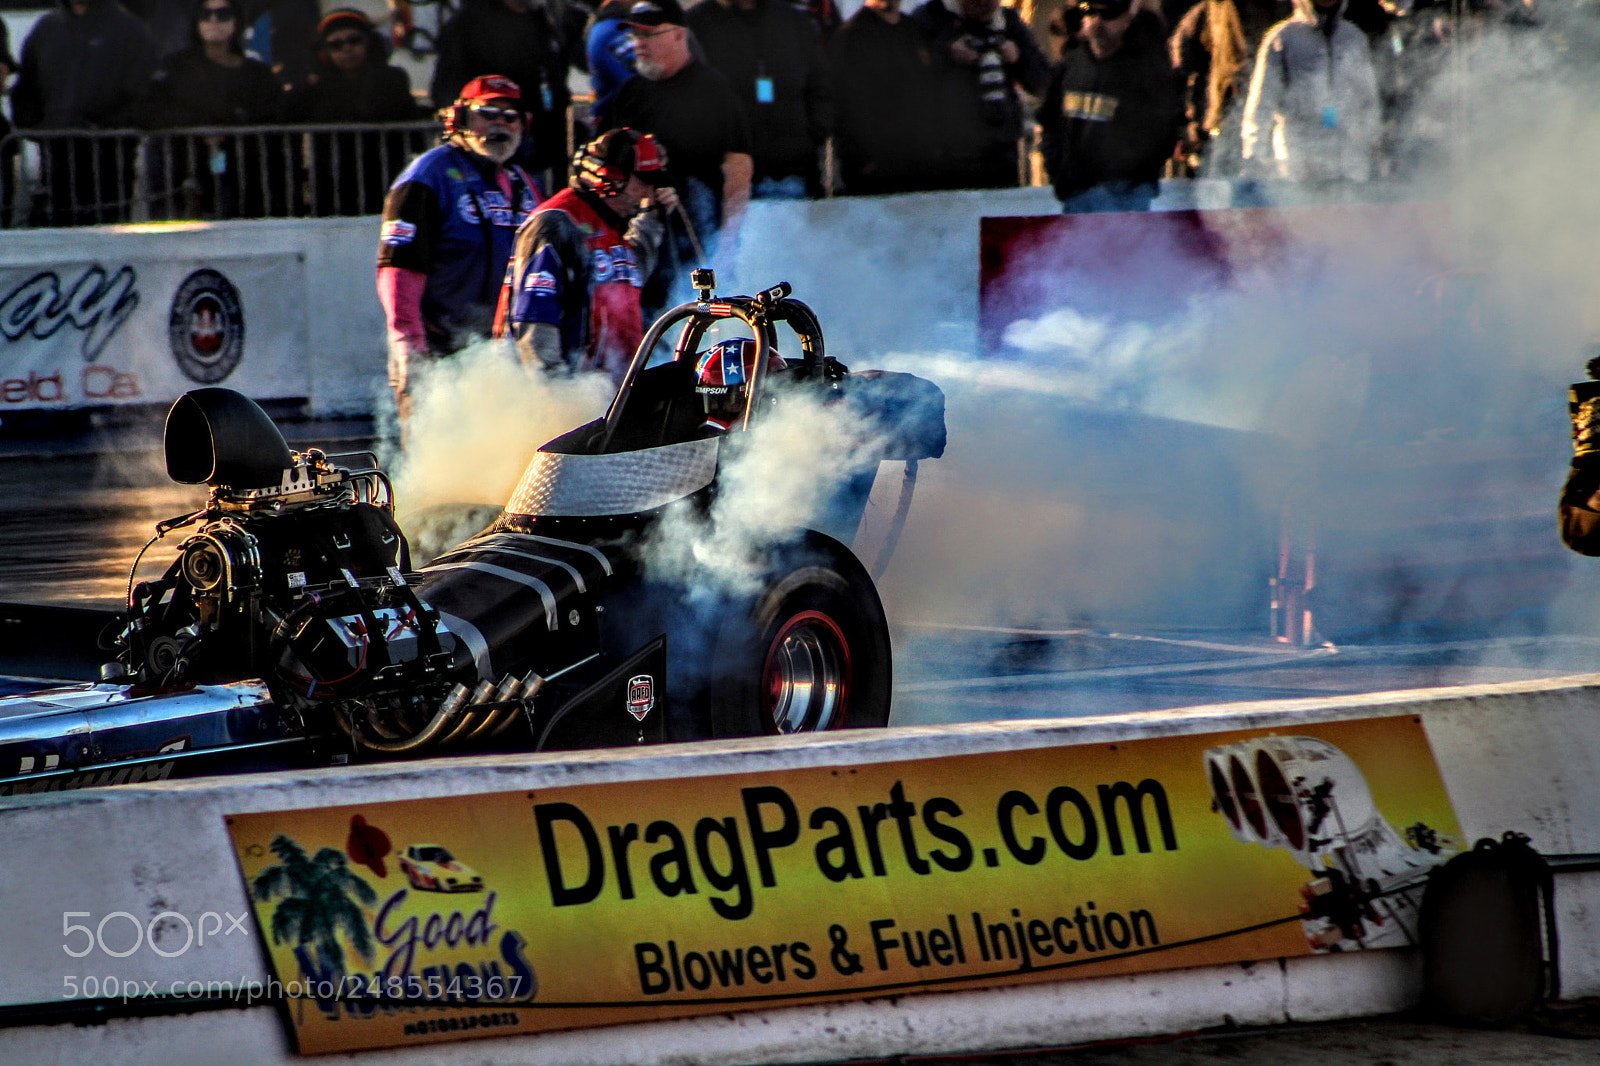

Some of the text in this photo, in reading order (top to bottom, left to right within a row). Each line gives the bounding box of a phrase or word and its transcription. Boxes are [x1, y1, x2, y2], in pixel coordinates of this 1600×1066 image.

[534, 777, 1178, 920] DragParts.com
[375, 889, 499, 984] Good
[634, 901, 1159, 996] Blowers & Fuel Injection
